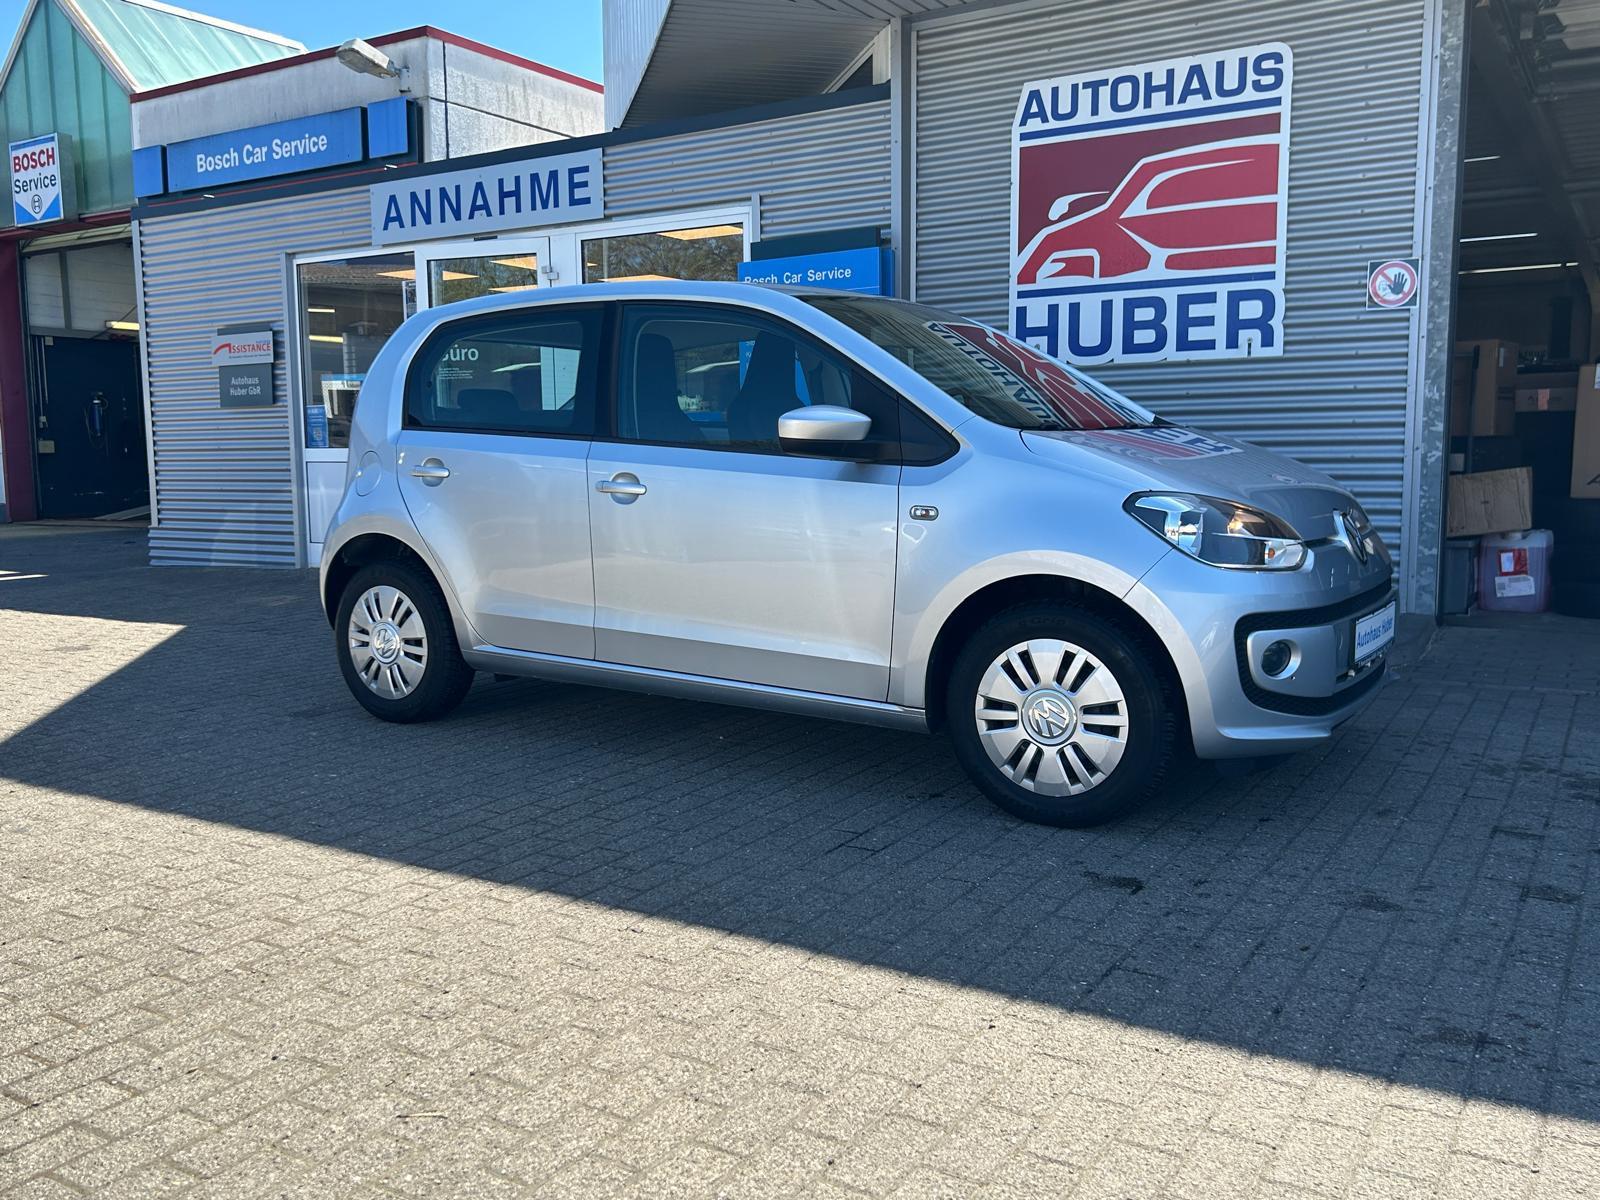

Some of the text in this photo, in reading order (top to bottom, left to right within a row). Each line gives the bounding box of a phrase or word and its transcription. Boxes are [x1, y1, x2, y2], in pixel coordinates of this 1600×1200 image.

[1018, 51, 1285, 127] AUTOHAUS
[13, 146, 56, 173] BOSCH
[196, 133, 328, 173] Bosch Car Service
[14, 172, 57, 194] Service
[382, 164, 592, 232] ANNAHME
[783, 272, 802, 284] Car
[807, 267, 852, 282] Service
[1015, 288, 1277, 358] HUBER
[441, 343, 479, 361] üro
[230, 386, 261, 396] Huber GbR
[231, 376, 260, 386] Autohaus
